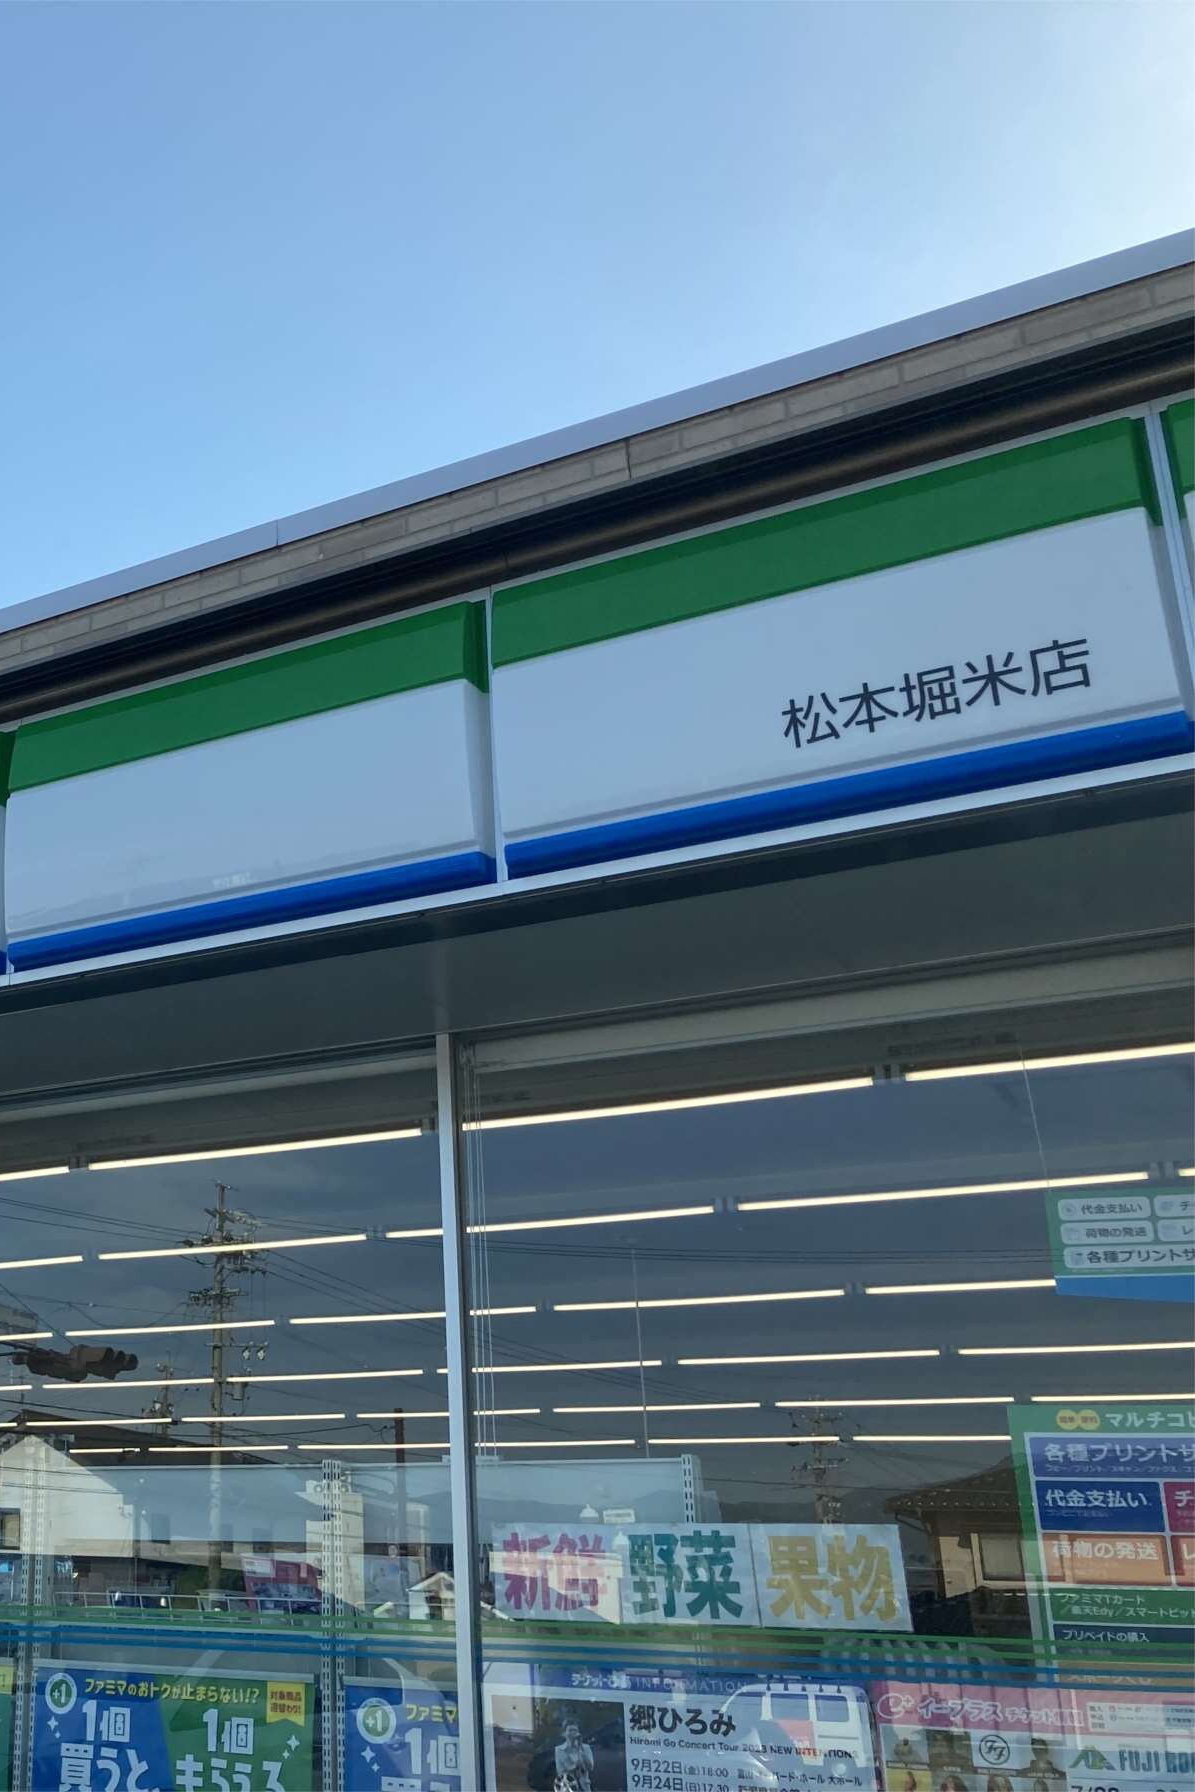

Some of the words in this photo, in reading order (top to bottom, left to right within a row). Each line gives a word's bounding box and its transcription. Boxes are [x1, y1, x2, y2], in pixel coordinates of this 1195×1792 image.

[781, 638, 1091, 748] 松本堀米店
[1081, 1203, 1143, 1215] 代金支払い
[1045, 1489, 1147, 1508] 代金支払い
[503, 1532, 608, 1611] 新鮮
[628, 1530, 743, 1619] 野菜
[766, 1534, 898, 1621] 果物
[85, 1678, 260, 1705] ファミマのおトクが止まらない!?
[82, 1700, 131, 1742] 1個
[202, 1708, 254, 1755] 1個
[629, 1704, 737, 1737] 郷ひろみ
[629, 1736, 662, 1747] Hiromi
[663, 1738, 676, 1748] Go
[679, 1740, 716, 1750] Concert
[718, 1742, 739, 1751] Tour
[770, 1744, 792, 1755] NEW
[795, 1746, 857, 1759] INTETIONS
[1118, 1749, 1161, 1773] FUJI
[1165, 1750, 1195, 1774] RO
